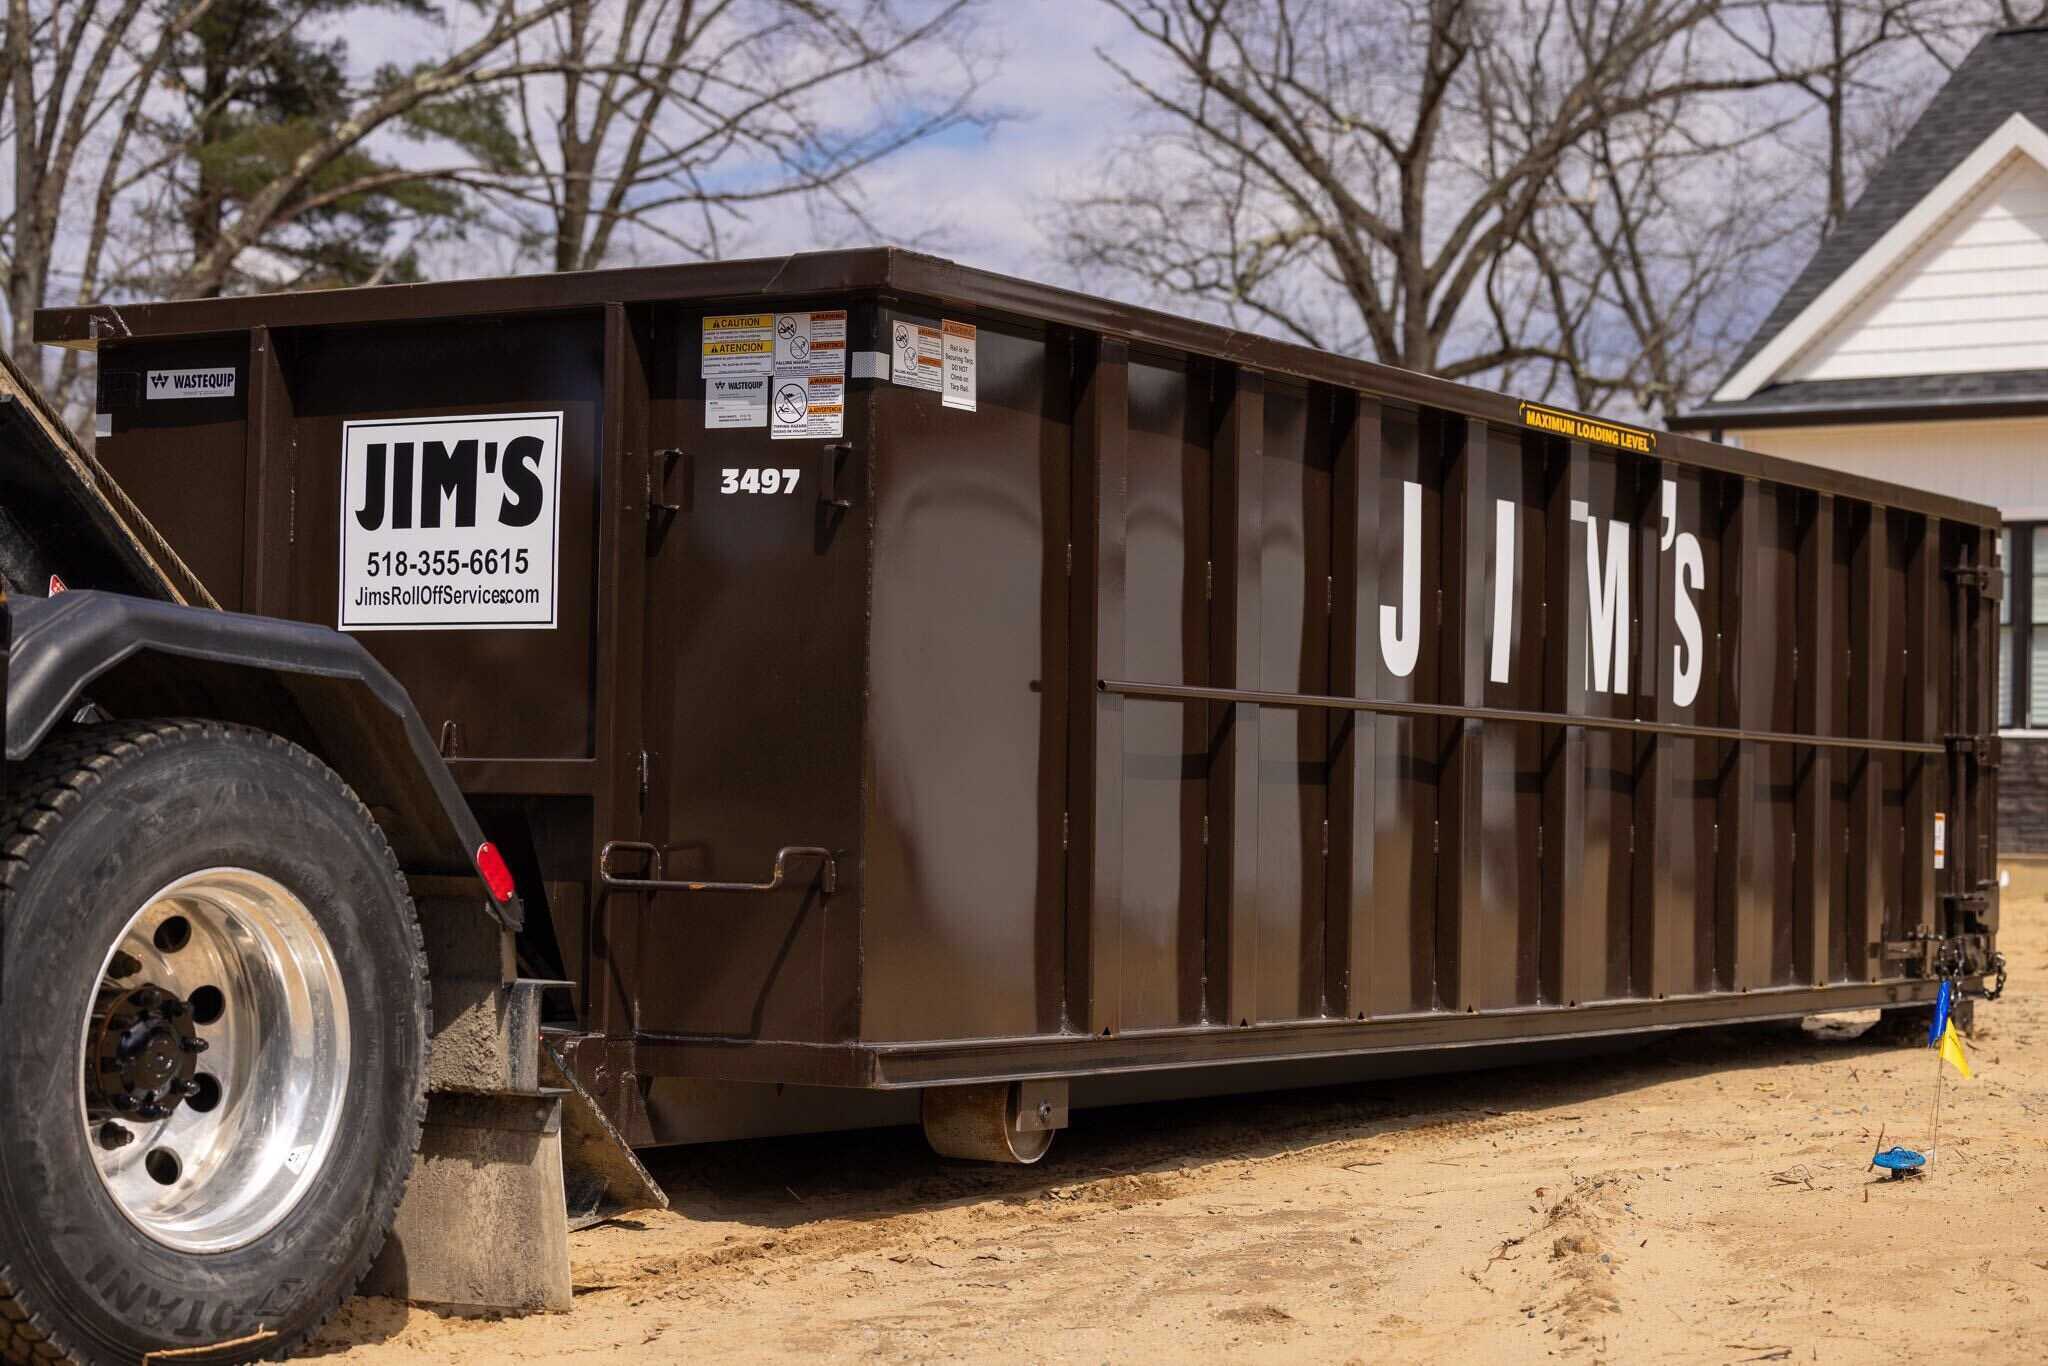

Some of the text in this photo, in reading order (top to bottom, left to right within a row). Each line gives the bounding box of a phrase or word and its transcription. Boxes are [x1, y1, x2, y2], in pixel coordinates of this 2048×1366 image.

[721, 318, 760, 327] CAUTION
[720, 343, 763, 352] ATENCION
[174, 373, 234, 389] WASTEQUIP
[728, 381, 763, 390] WASTEQUIP
[1526, 411, 1649, 452] MAXIMUM LOADING LEVEL
[355, 436, 544, 531] JIM'S
[720, 468, 800, 495] 3497
[367, 548, 529, 577] 518-355-6615
